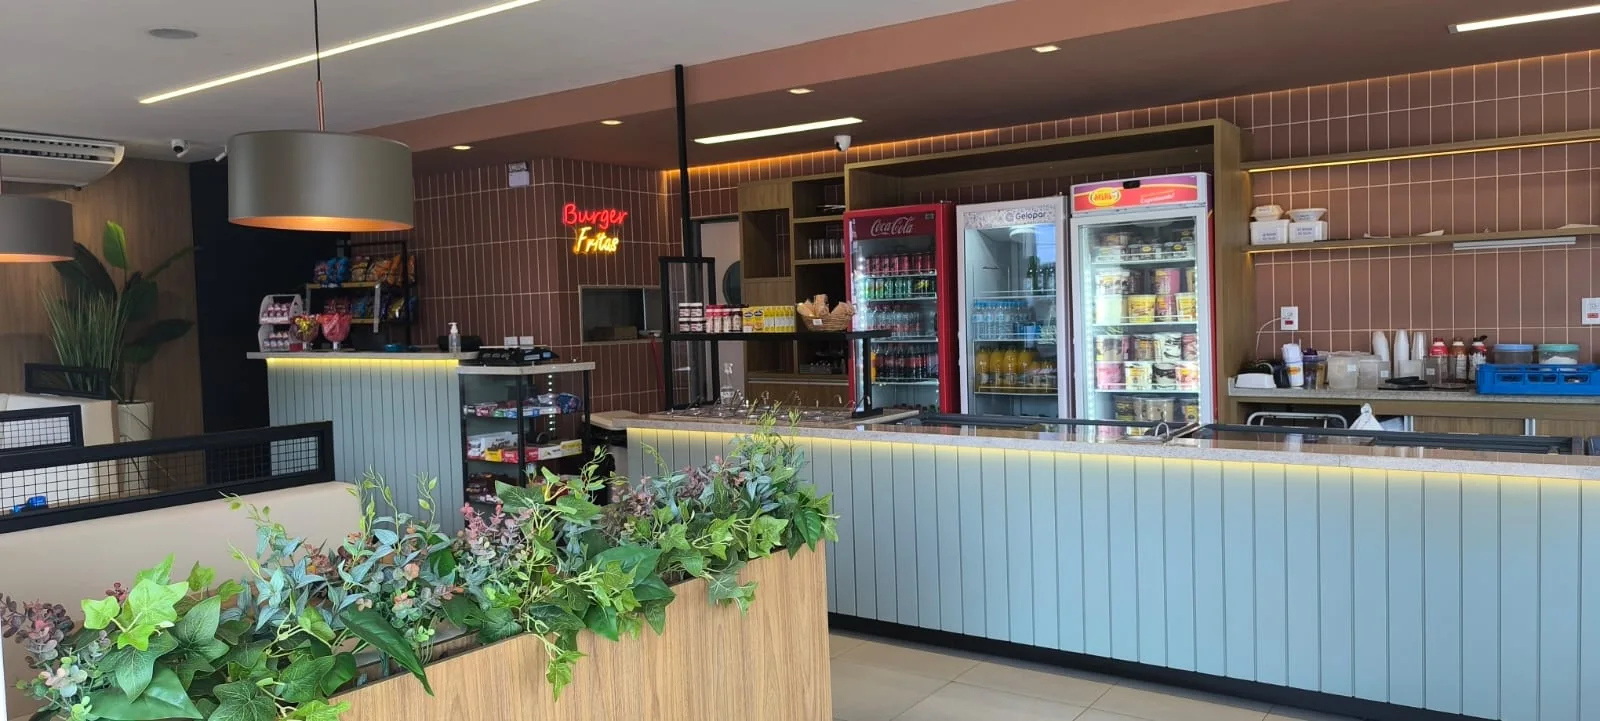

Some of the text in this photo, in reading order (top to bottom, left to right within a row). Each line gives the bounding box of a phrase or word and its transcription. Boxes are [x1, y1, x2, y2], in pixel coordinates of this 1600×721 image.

[563, 203, 628, 230] Burger
[1015, 211, 1047, 222] Gelopar
[574, 226, 620, 253] Fritas
